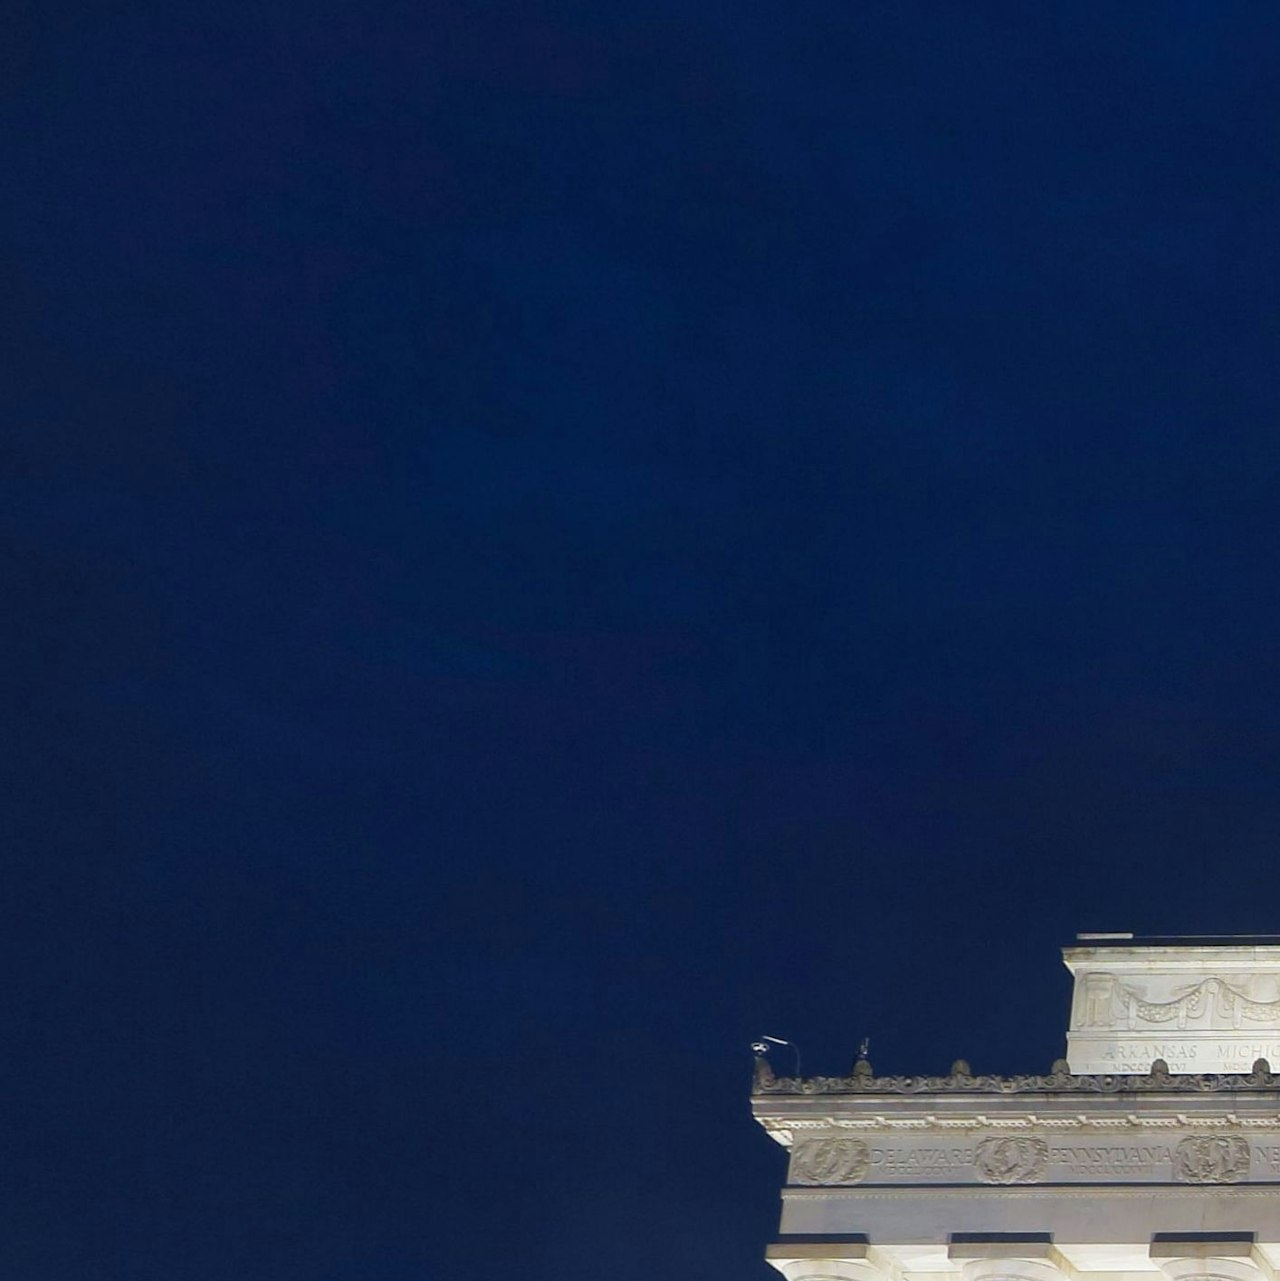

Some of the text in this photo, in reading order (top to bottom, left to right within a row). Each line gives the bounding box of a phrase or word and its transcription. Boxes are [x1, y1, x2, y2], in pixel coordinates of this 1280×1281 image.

[1103, 1045, 1198, 1060] ARKANSAS
[871, 1148, 974, 1165] DELAWARE
[1048, 1147, 1172, 1165] PENNSYLVANIA
